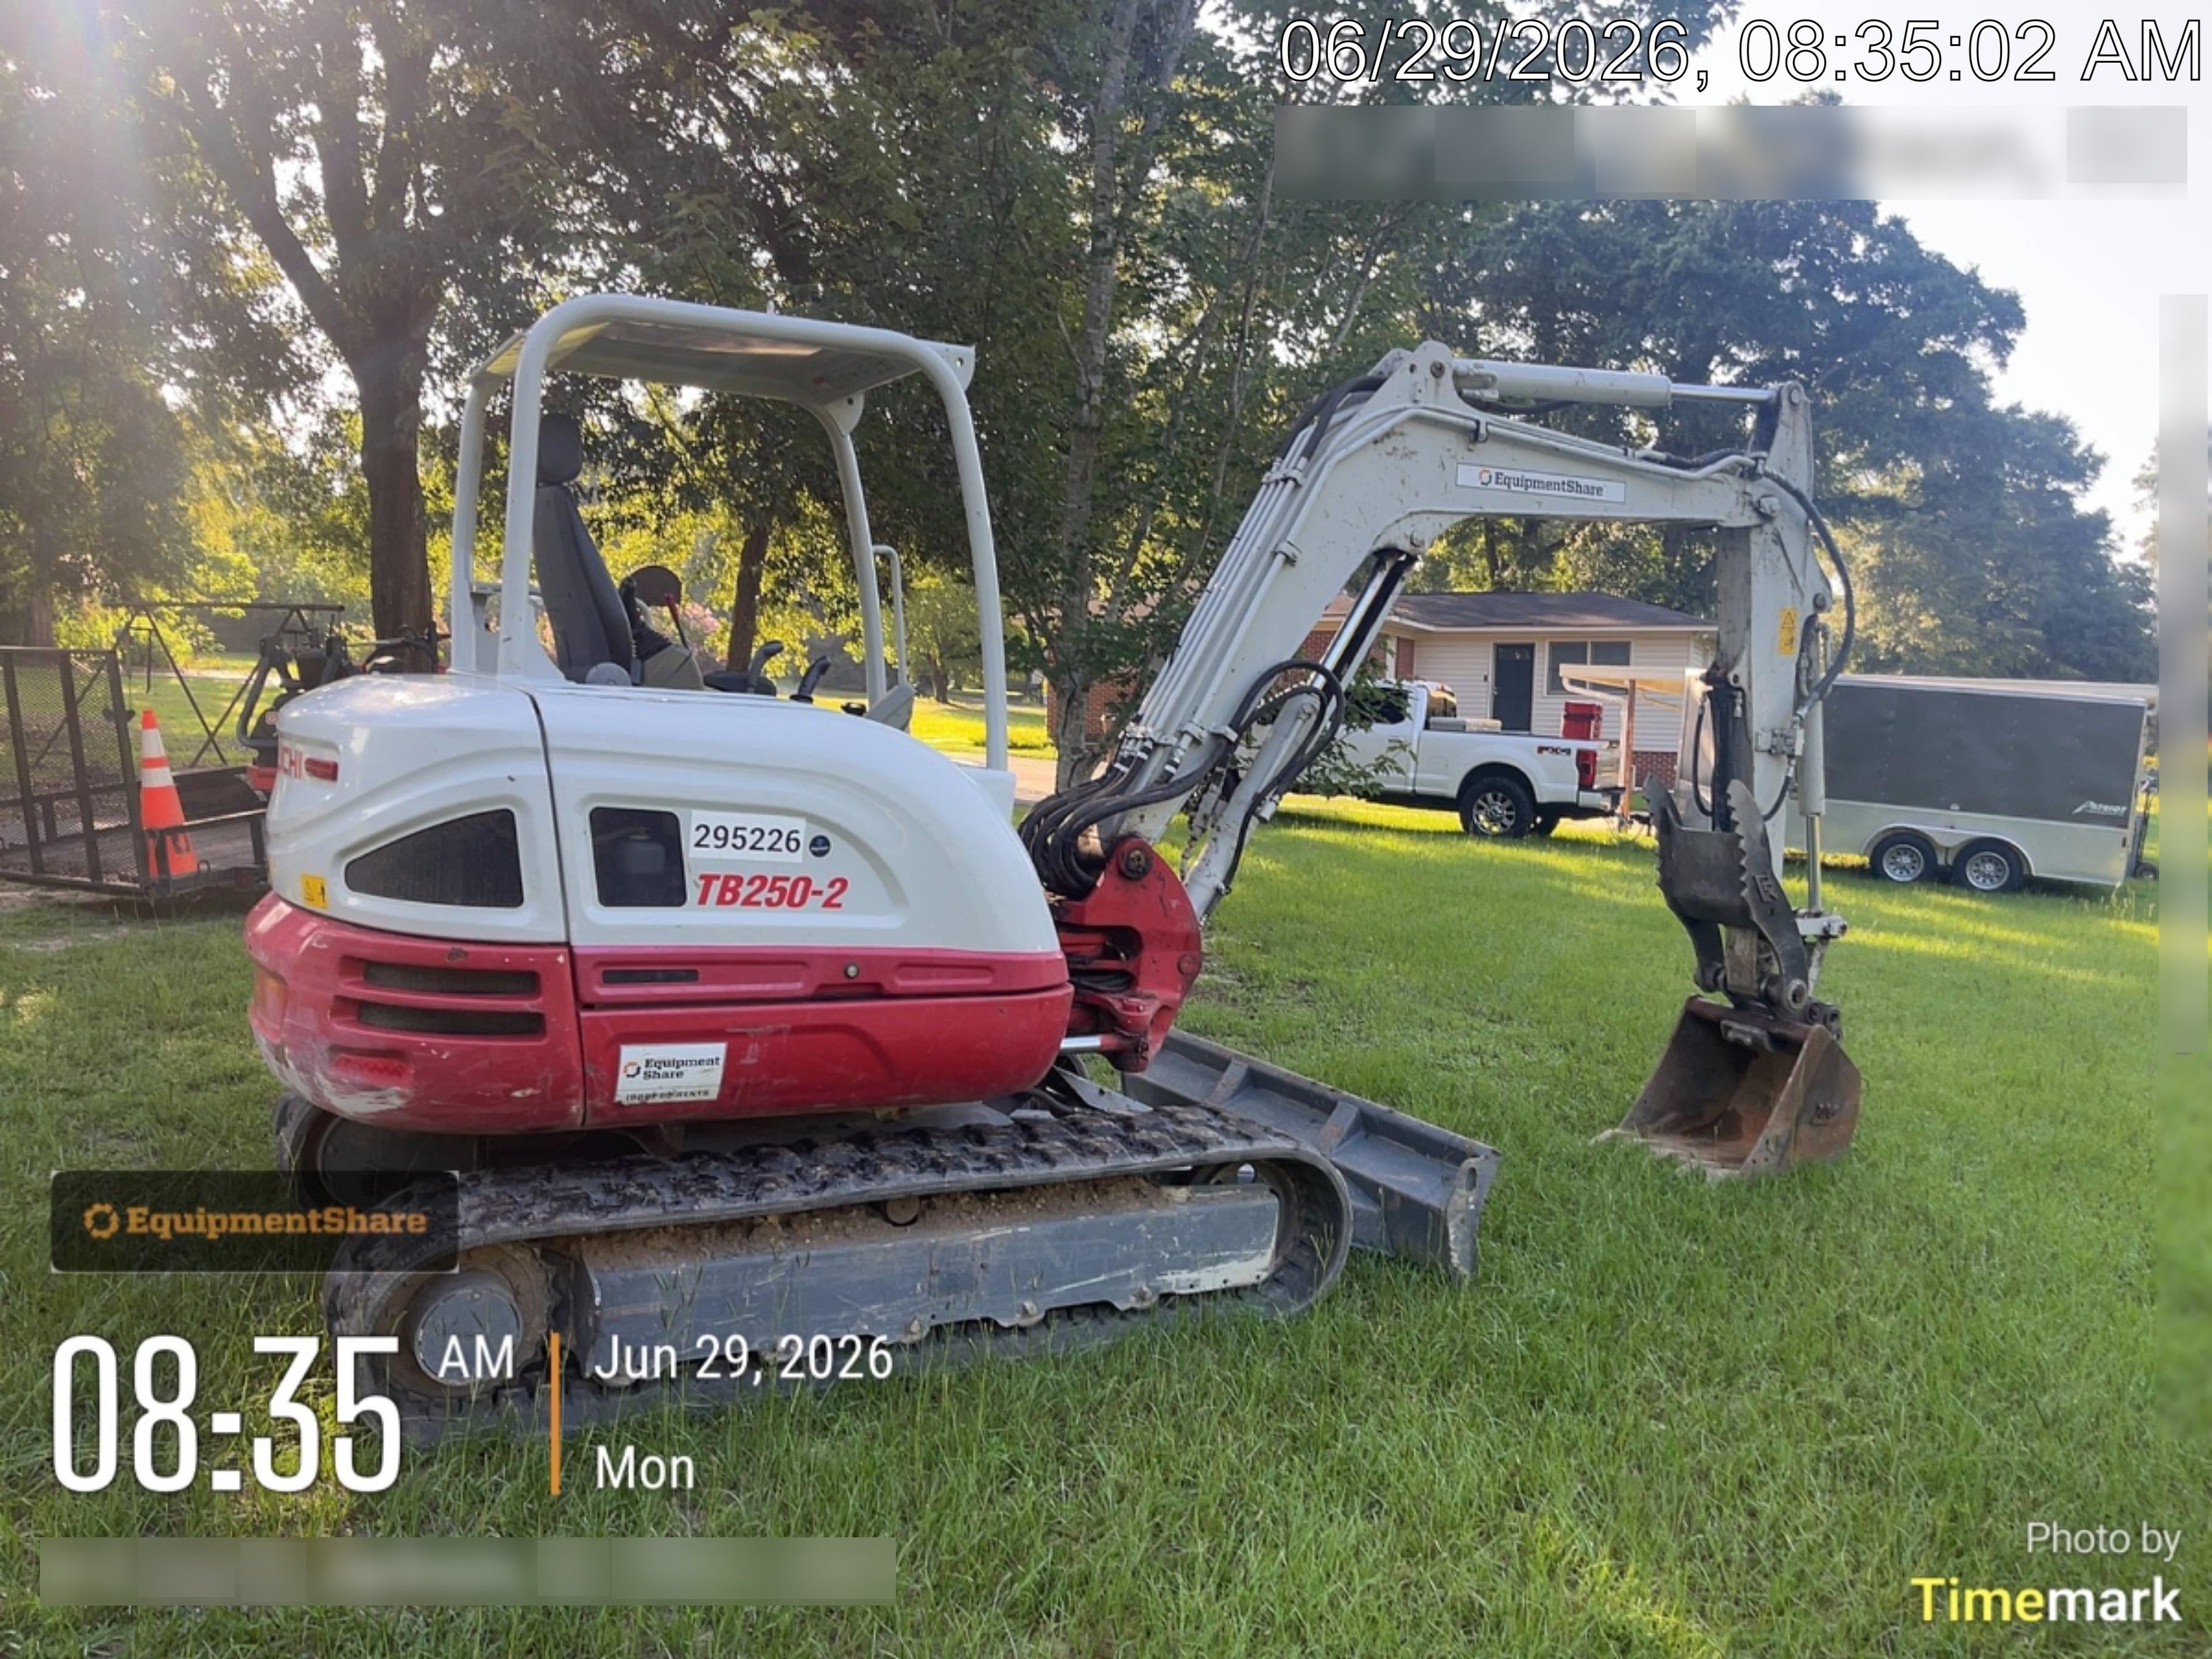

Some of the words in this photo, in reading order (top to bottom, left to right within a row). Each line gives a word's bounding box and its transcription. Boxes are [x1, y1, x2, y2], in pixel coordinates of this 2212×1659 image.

[1494, 471, 1604, 496] EquipmentShare
[693, 823, 801, 853] 295226
[697, 873, 849, 909] TB250-2
[643, 1070, 684, 1080] Share
[644, 1056, 721, 1070] Equipment
